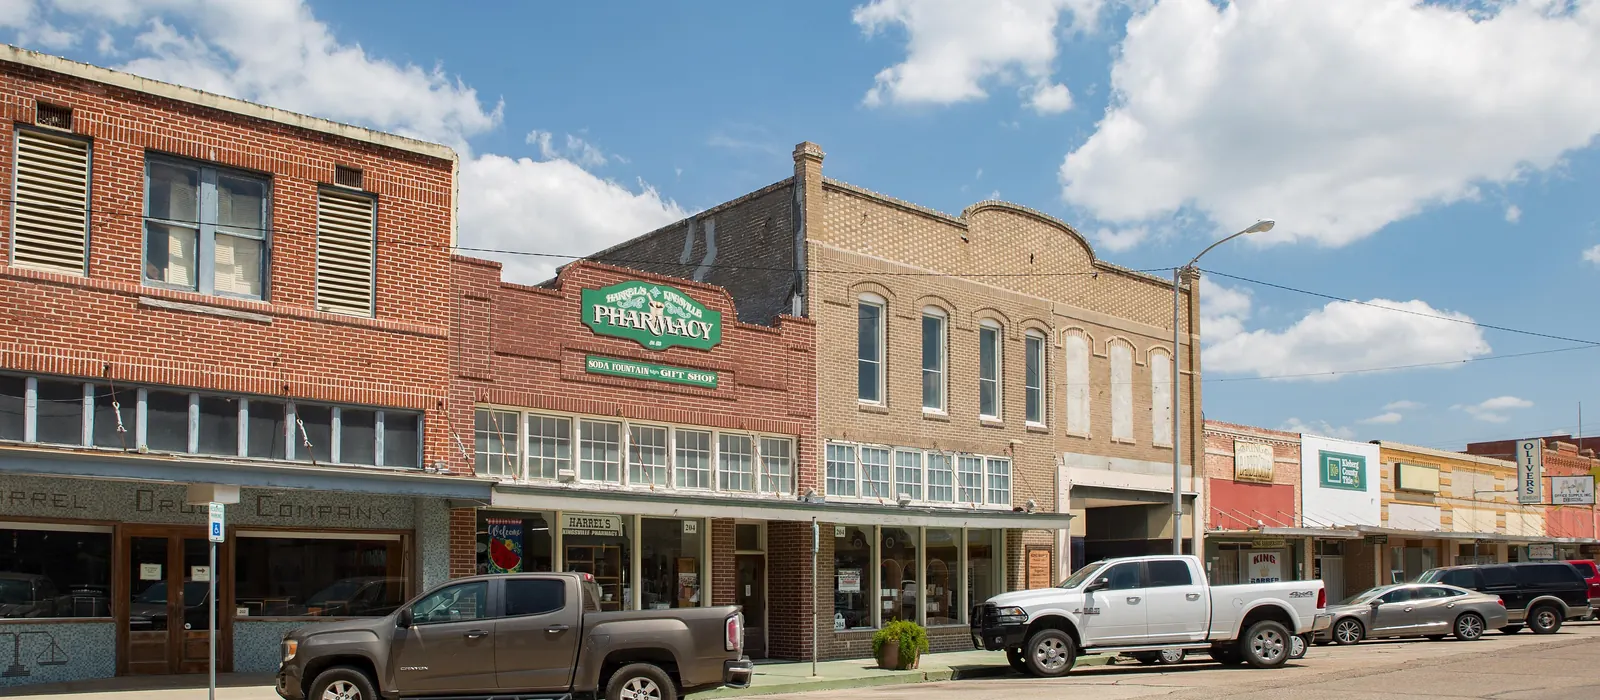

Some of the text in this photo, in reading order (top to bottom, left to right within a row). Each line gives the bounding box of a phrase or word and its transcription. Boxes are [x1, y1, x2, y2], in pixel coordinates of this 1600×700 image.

[606, 286, 702, 318] HARREL'S KINGSVILLE
[593, 304, 713, 341] PHARMACY
[588, 360, 715, 383] SODA FOUNTAIN GIFT SHOP
[1341, 458, 1359, 470] Kleberg
[1523, 442, 1535, 495] OLIVERS
[0, 490, 88, 508] RREL
[256, 495, 391, 520] COMPANY
[488, 524, 521, 539] Welcome
[569, 517, 611, 529] HARREL'S
[1253, 553, 1276, 565] KING
